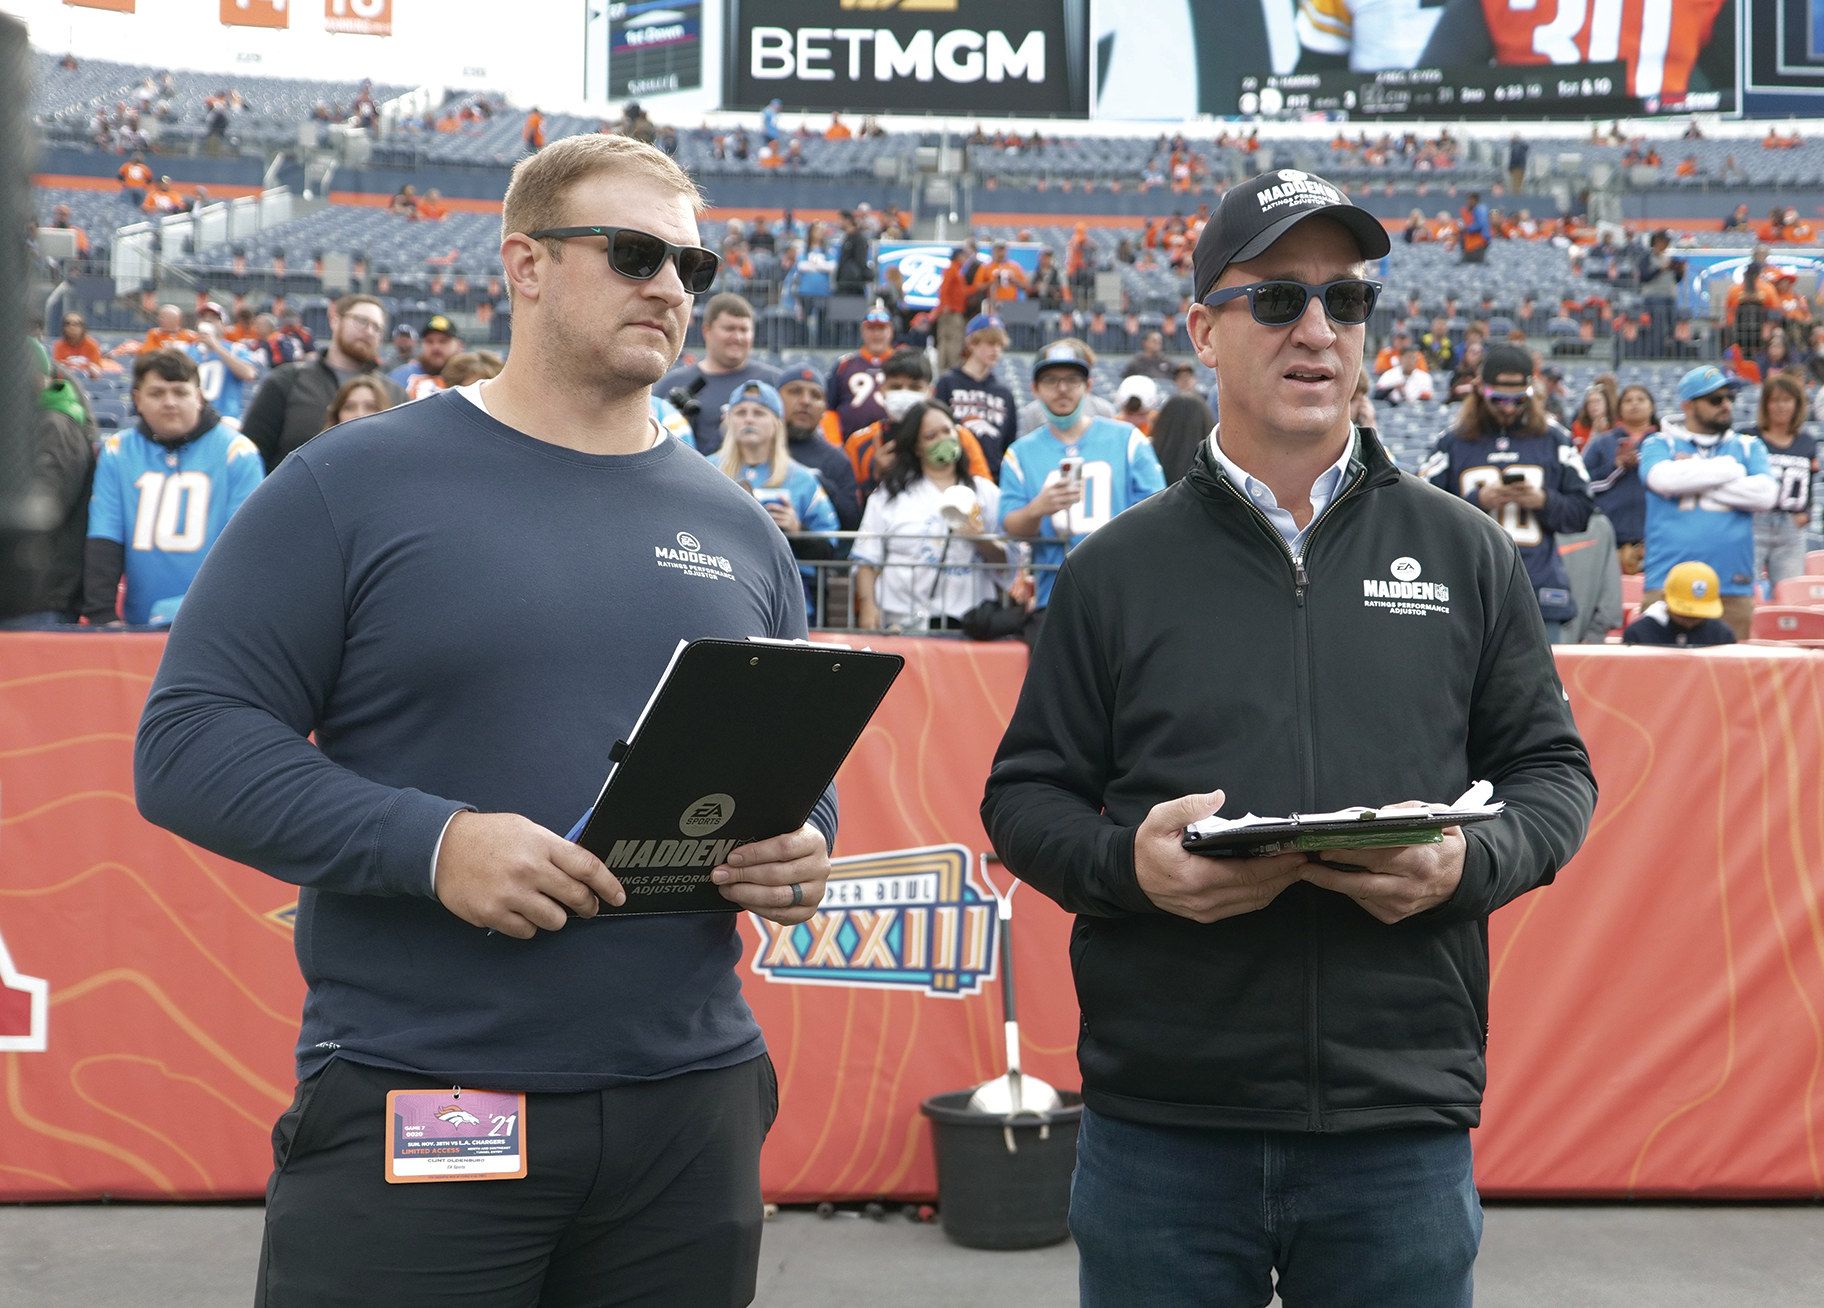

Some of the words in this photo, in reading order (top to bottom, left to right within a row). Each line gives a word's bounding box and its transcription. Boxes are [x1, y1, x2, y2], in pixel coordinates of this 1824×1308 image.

[750, 26, 1046, 83] BETMGM
[1256, 180, 1326, 206] MADDEN
[132, 470, 212, 553] 10
[655, 546, 719, 568] MADDEN
[656, 560, 689, 570] RATINGS
[688, 565, 736, 581] PERFORMANCE
[683, 569, 719, 580] ADJUSTOR
[1396, 562, 1415, 571] EA
[1363, 579, 1434, 600] MADDEN
[1364, 600, 1396, 608] RATINGS
[1397, 602, 1450, 614] PERFORMANCE
[1389, 607, 1427, 616] ADJUSTOR
[690, 802, 723, 817] EA
[686, 817, 721, 825] SPORTS
[605, 839, 737, 868] MADDEN
[650, 874, 713, 884] PERFORM
[631, 884, 696, 896] ADJUSTOR
[826, 884, 862, 903] PER
[876, 879, 929, 901] BOWL
[760, 905, 991, 972] XXXIII
[487, 1113, 517, 1137] '21
[471, 1138, 506, 1146] CHARGERS
[401, 1148, 431, 1156] LIMITED
